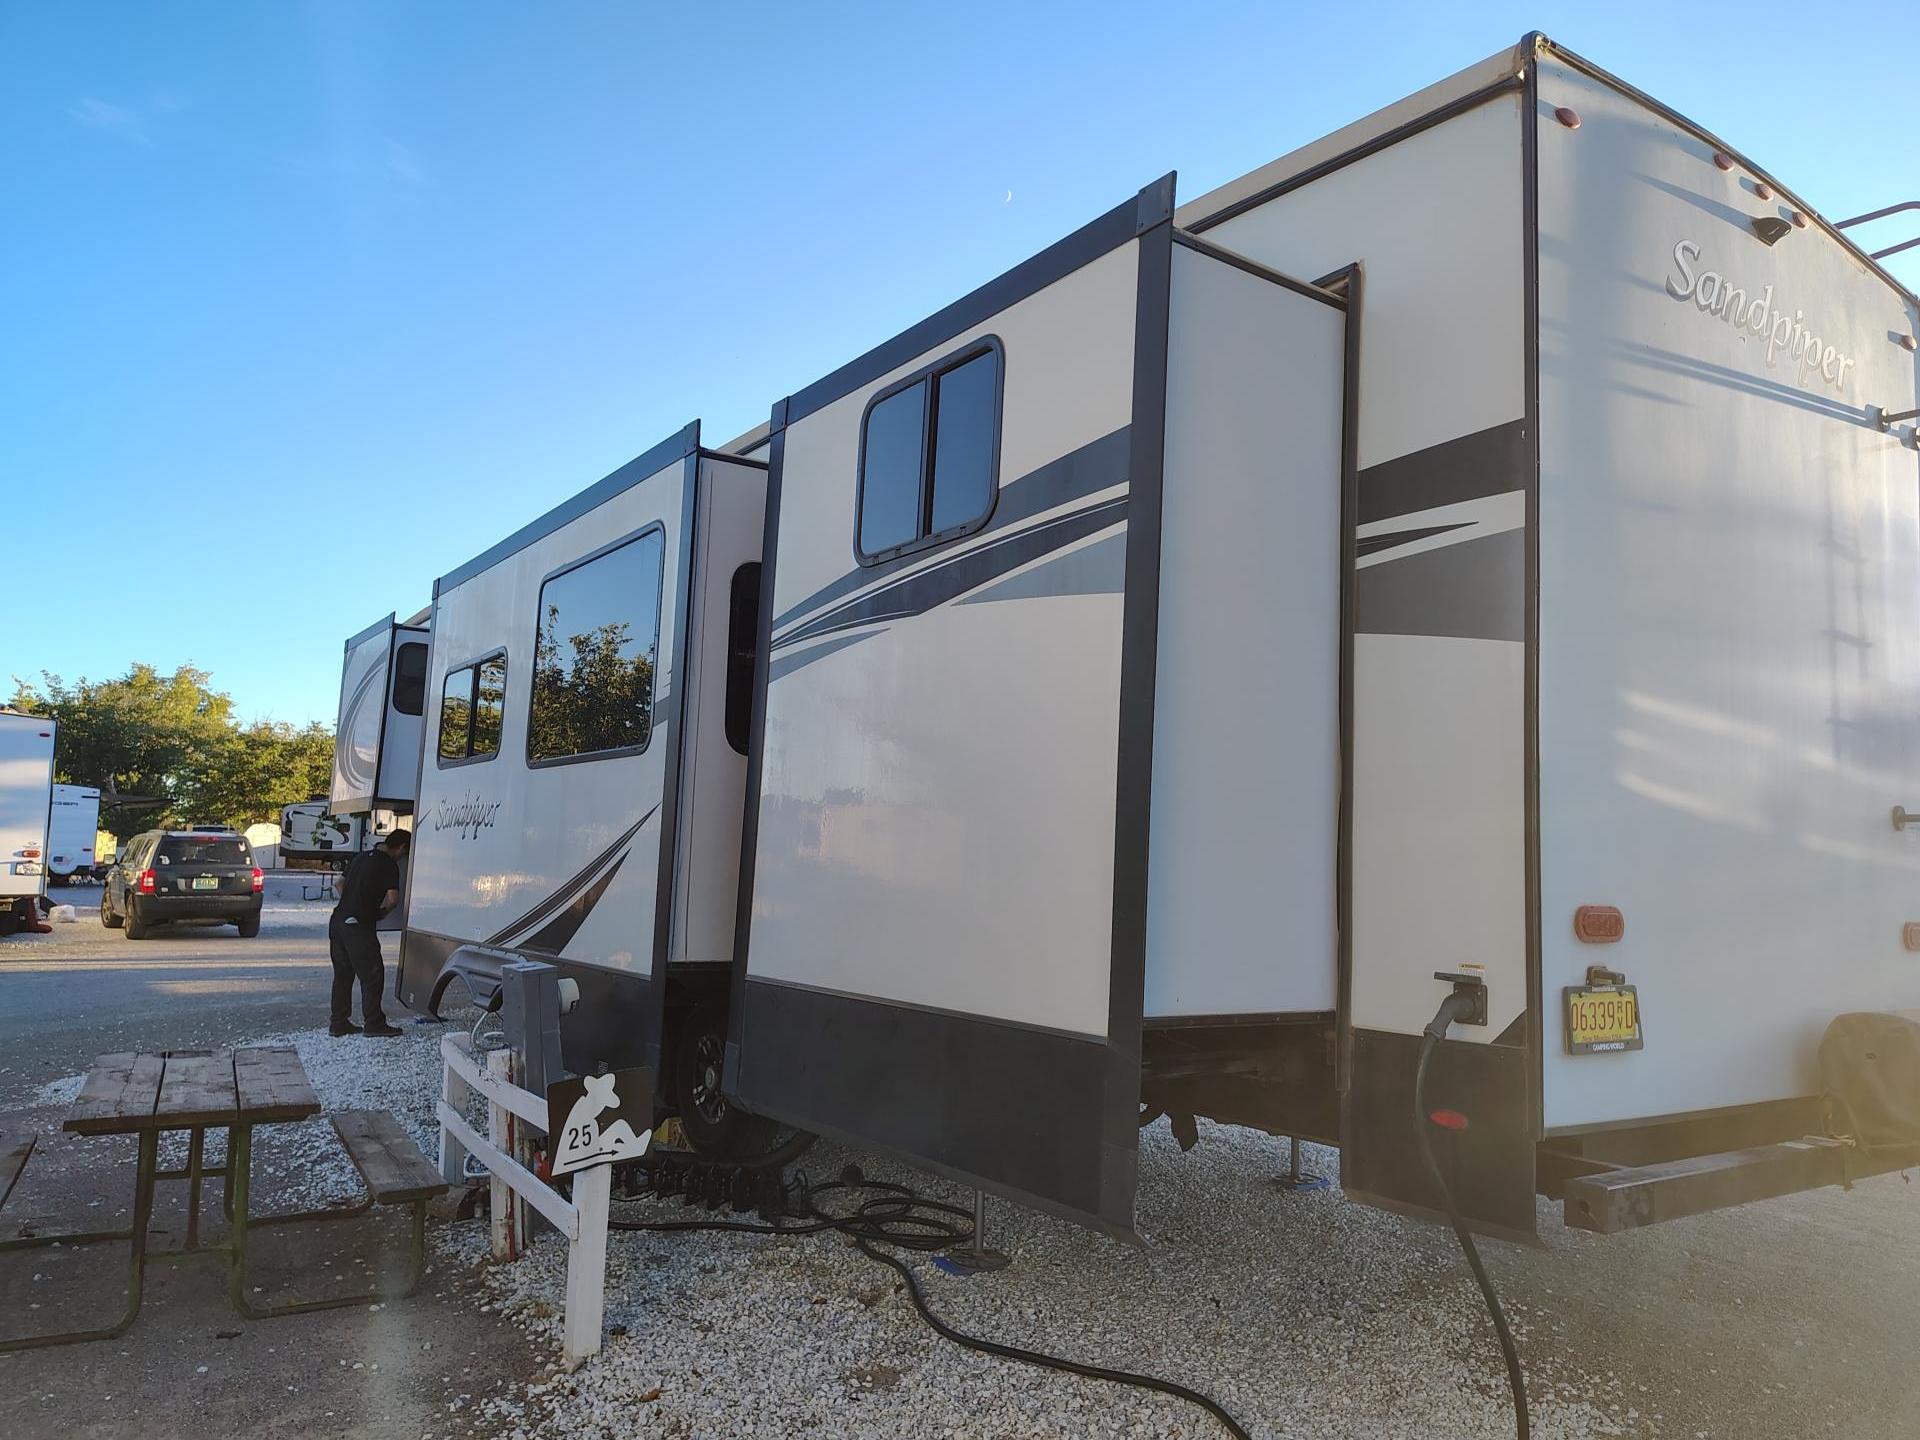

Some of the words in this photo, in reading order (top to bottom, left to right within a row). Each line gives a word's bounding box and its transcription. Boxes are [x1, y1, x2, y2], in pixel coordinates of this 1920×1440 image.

[1665, 239, 1854, 392] Sandpiper
[435, 788, 501, 840] Sandpiper
[569, 1124, 592, 1151] 25
